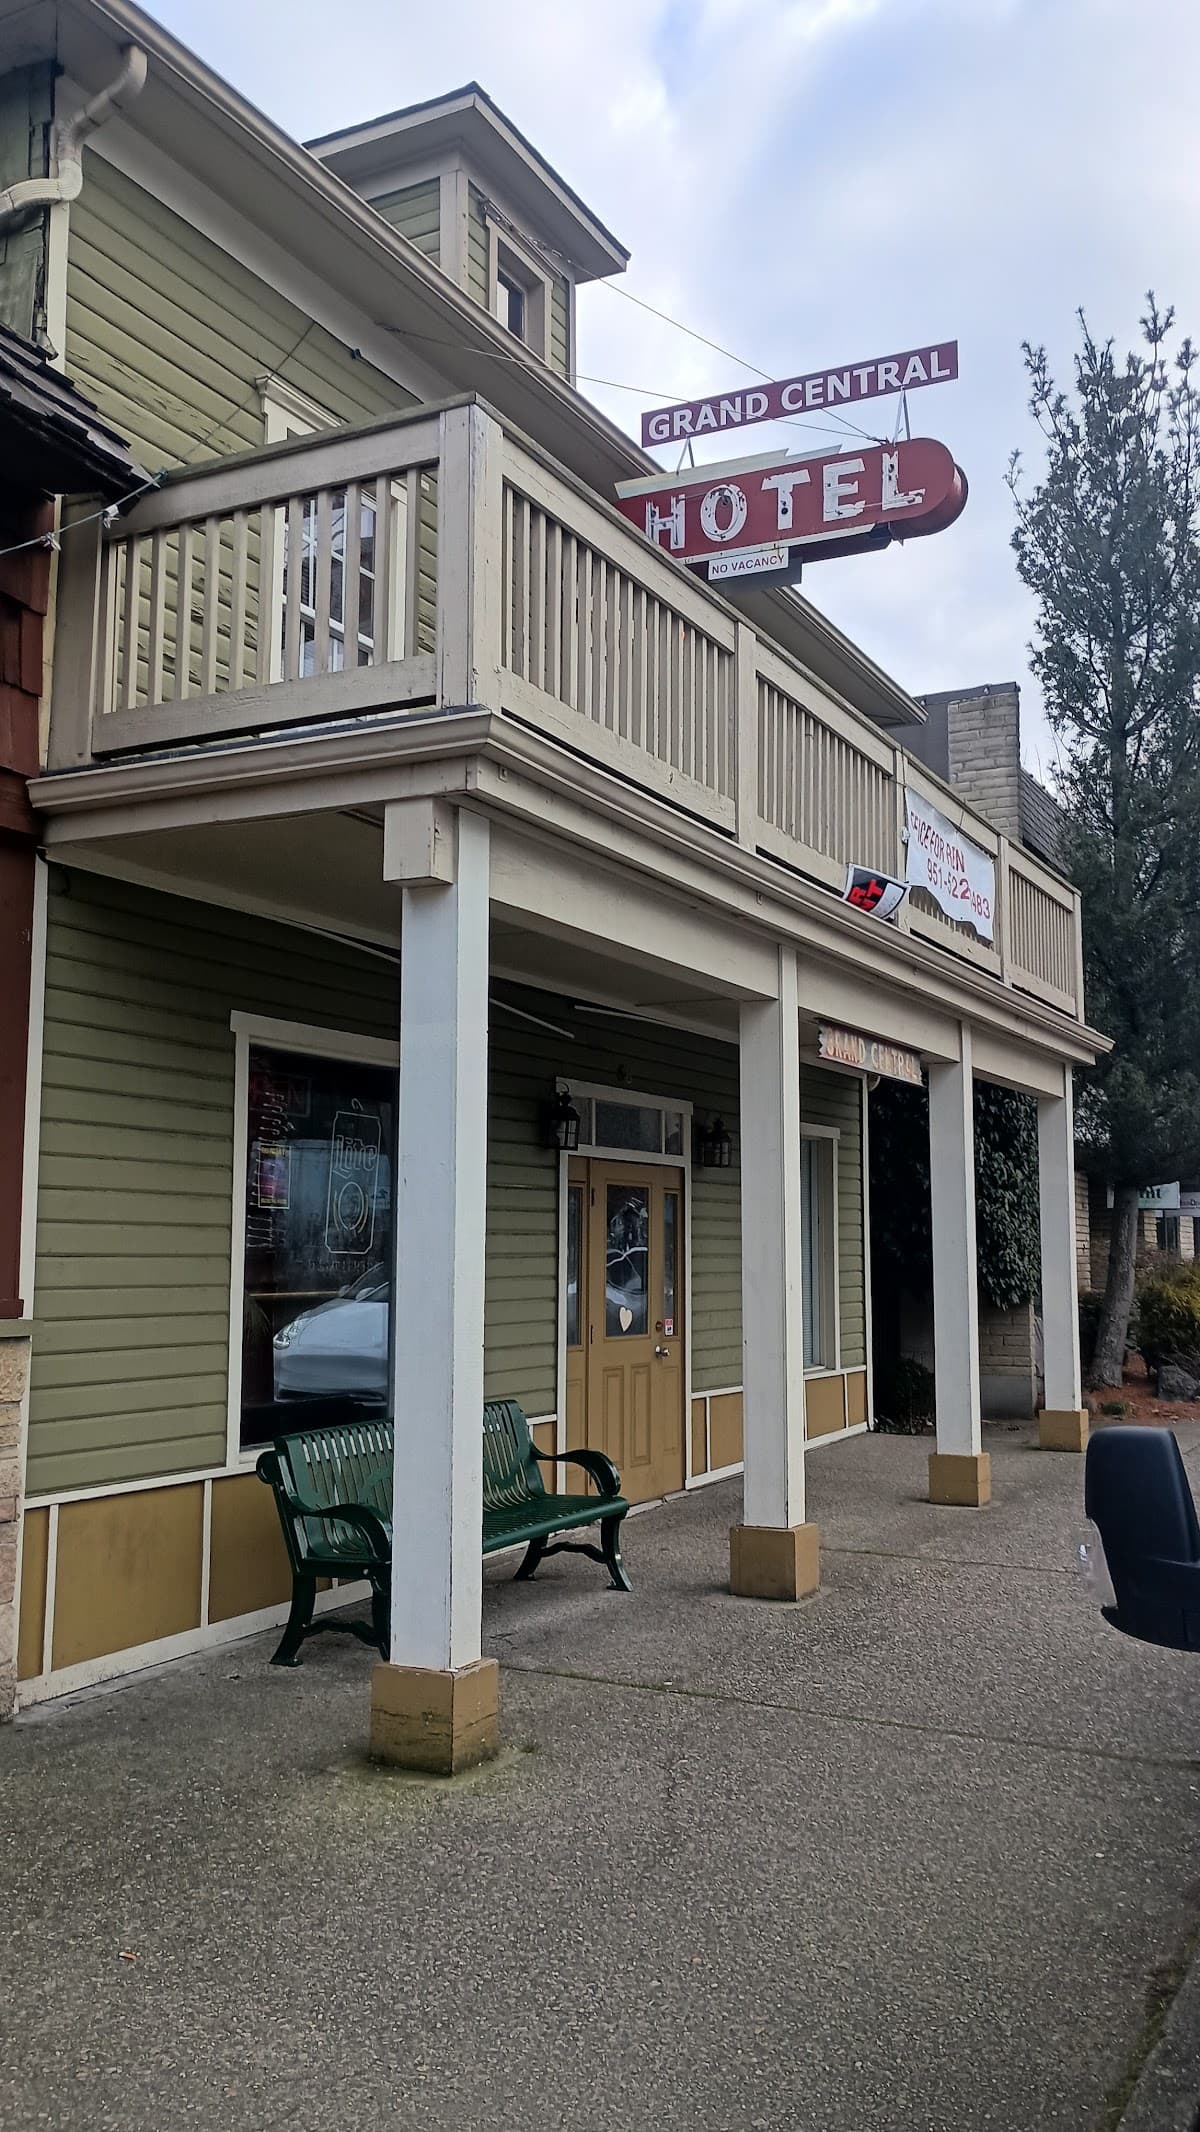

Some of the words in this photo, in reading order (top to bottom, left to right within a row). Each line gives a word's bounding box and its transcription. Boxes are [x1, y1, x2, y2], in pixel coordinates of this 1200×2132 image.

[648, 392, 769, 441] GRAND
[780, 351, 951, 410] CENTRAL
[645, 450, 926, 550] HOTEL
[712, 564, 728, 575] NO
[731, 554, 785, 572] VACANCY
[825, 1027, 866, 1063] GRAND
[871, 1042, 918, 1080] CENTRAL
